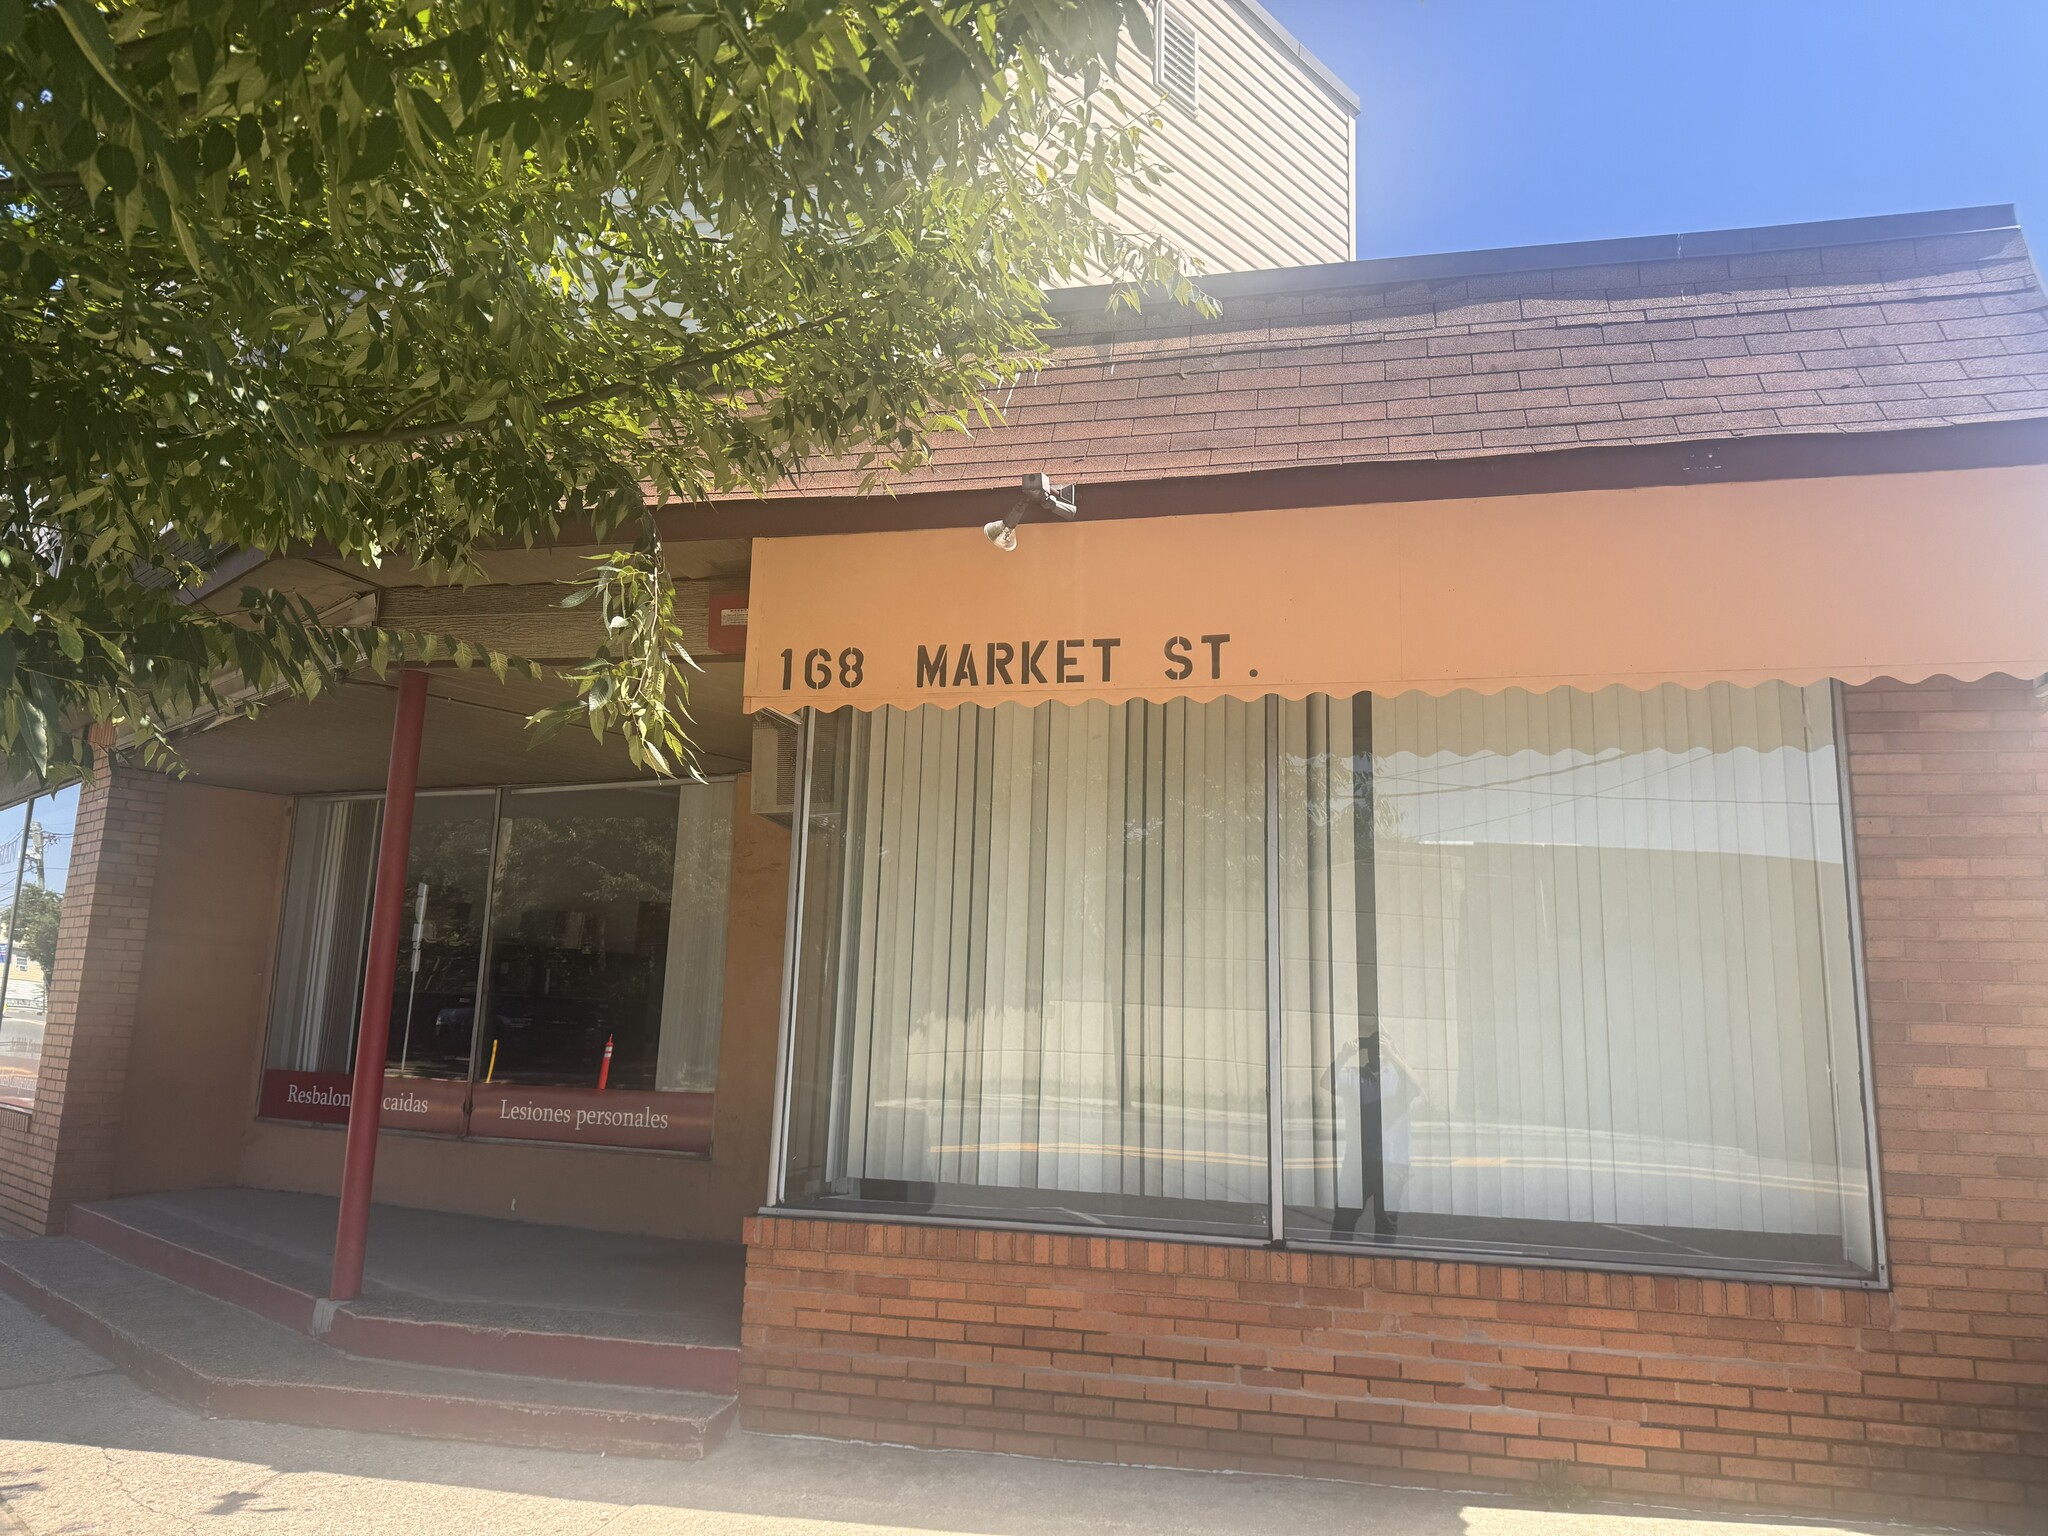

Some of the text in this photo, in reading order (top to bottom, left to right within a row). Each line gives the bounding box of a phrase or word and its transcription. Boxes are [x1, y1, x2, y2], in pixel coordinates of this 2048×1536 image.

[781, 633, 1259, 691] 168 MARKET ST.
[287, 1084, 429, 1113] Resbalon caidas
[499, 1098, 669, 1131] Lesiones personales
